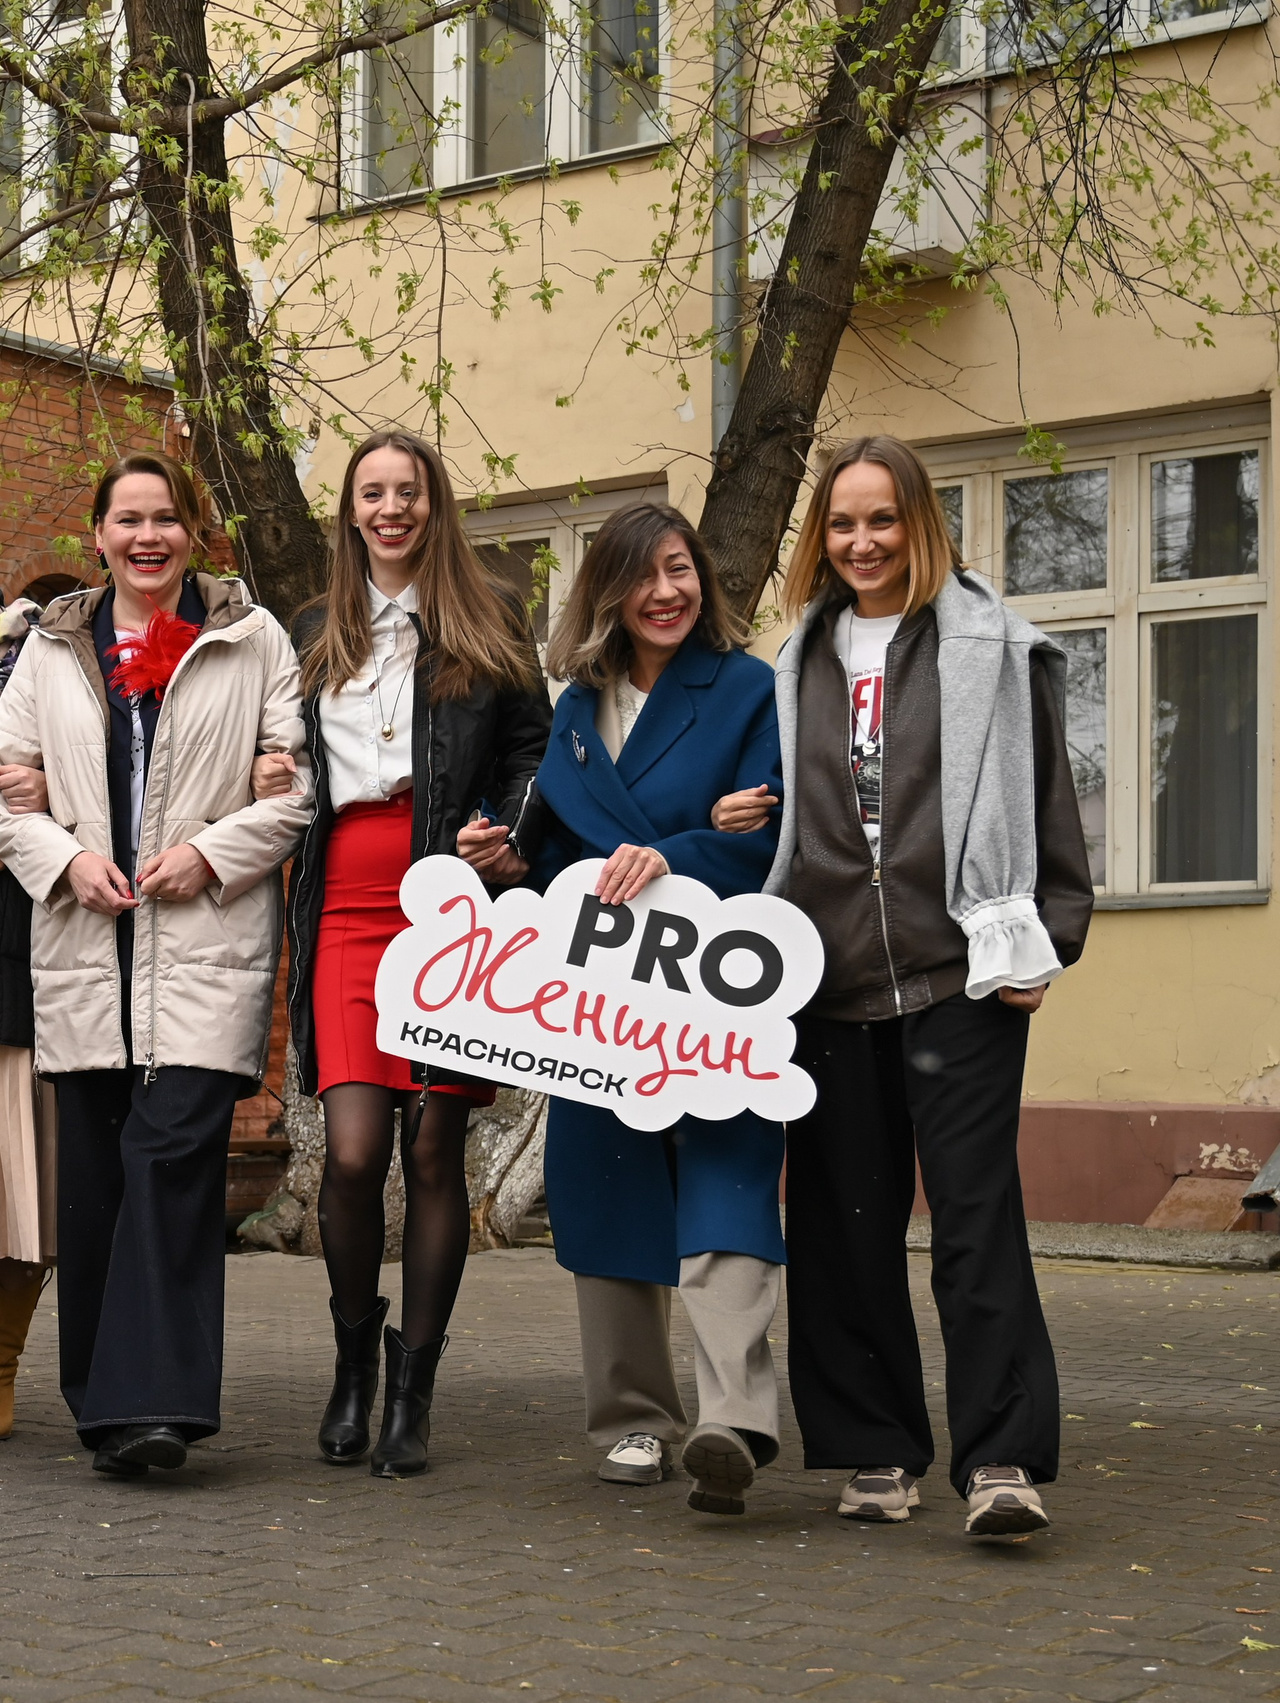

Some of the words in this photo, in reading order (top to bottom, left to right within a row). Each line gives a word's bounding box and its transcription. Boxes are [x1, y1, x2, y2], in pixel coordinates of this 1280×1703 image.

[413, 894, 781, 1097] Женщин
[566, 894, 784, 1008] PRO
[400, 1021, 628, 1097] КРАСНОЯРСК
